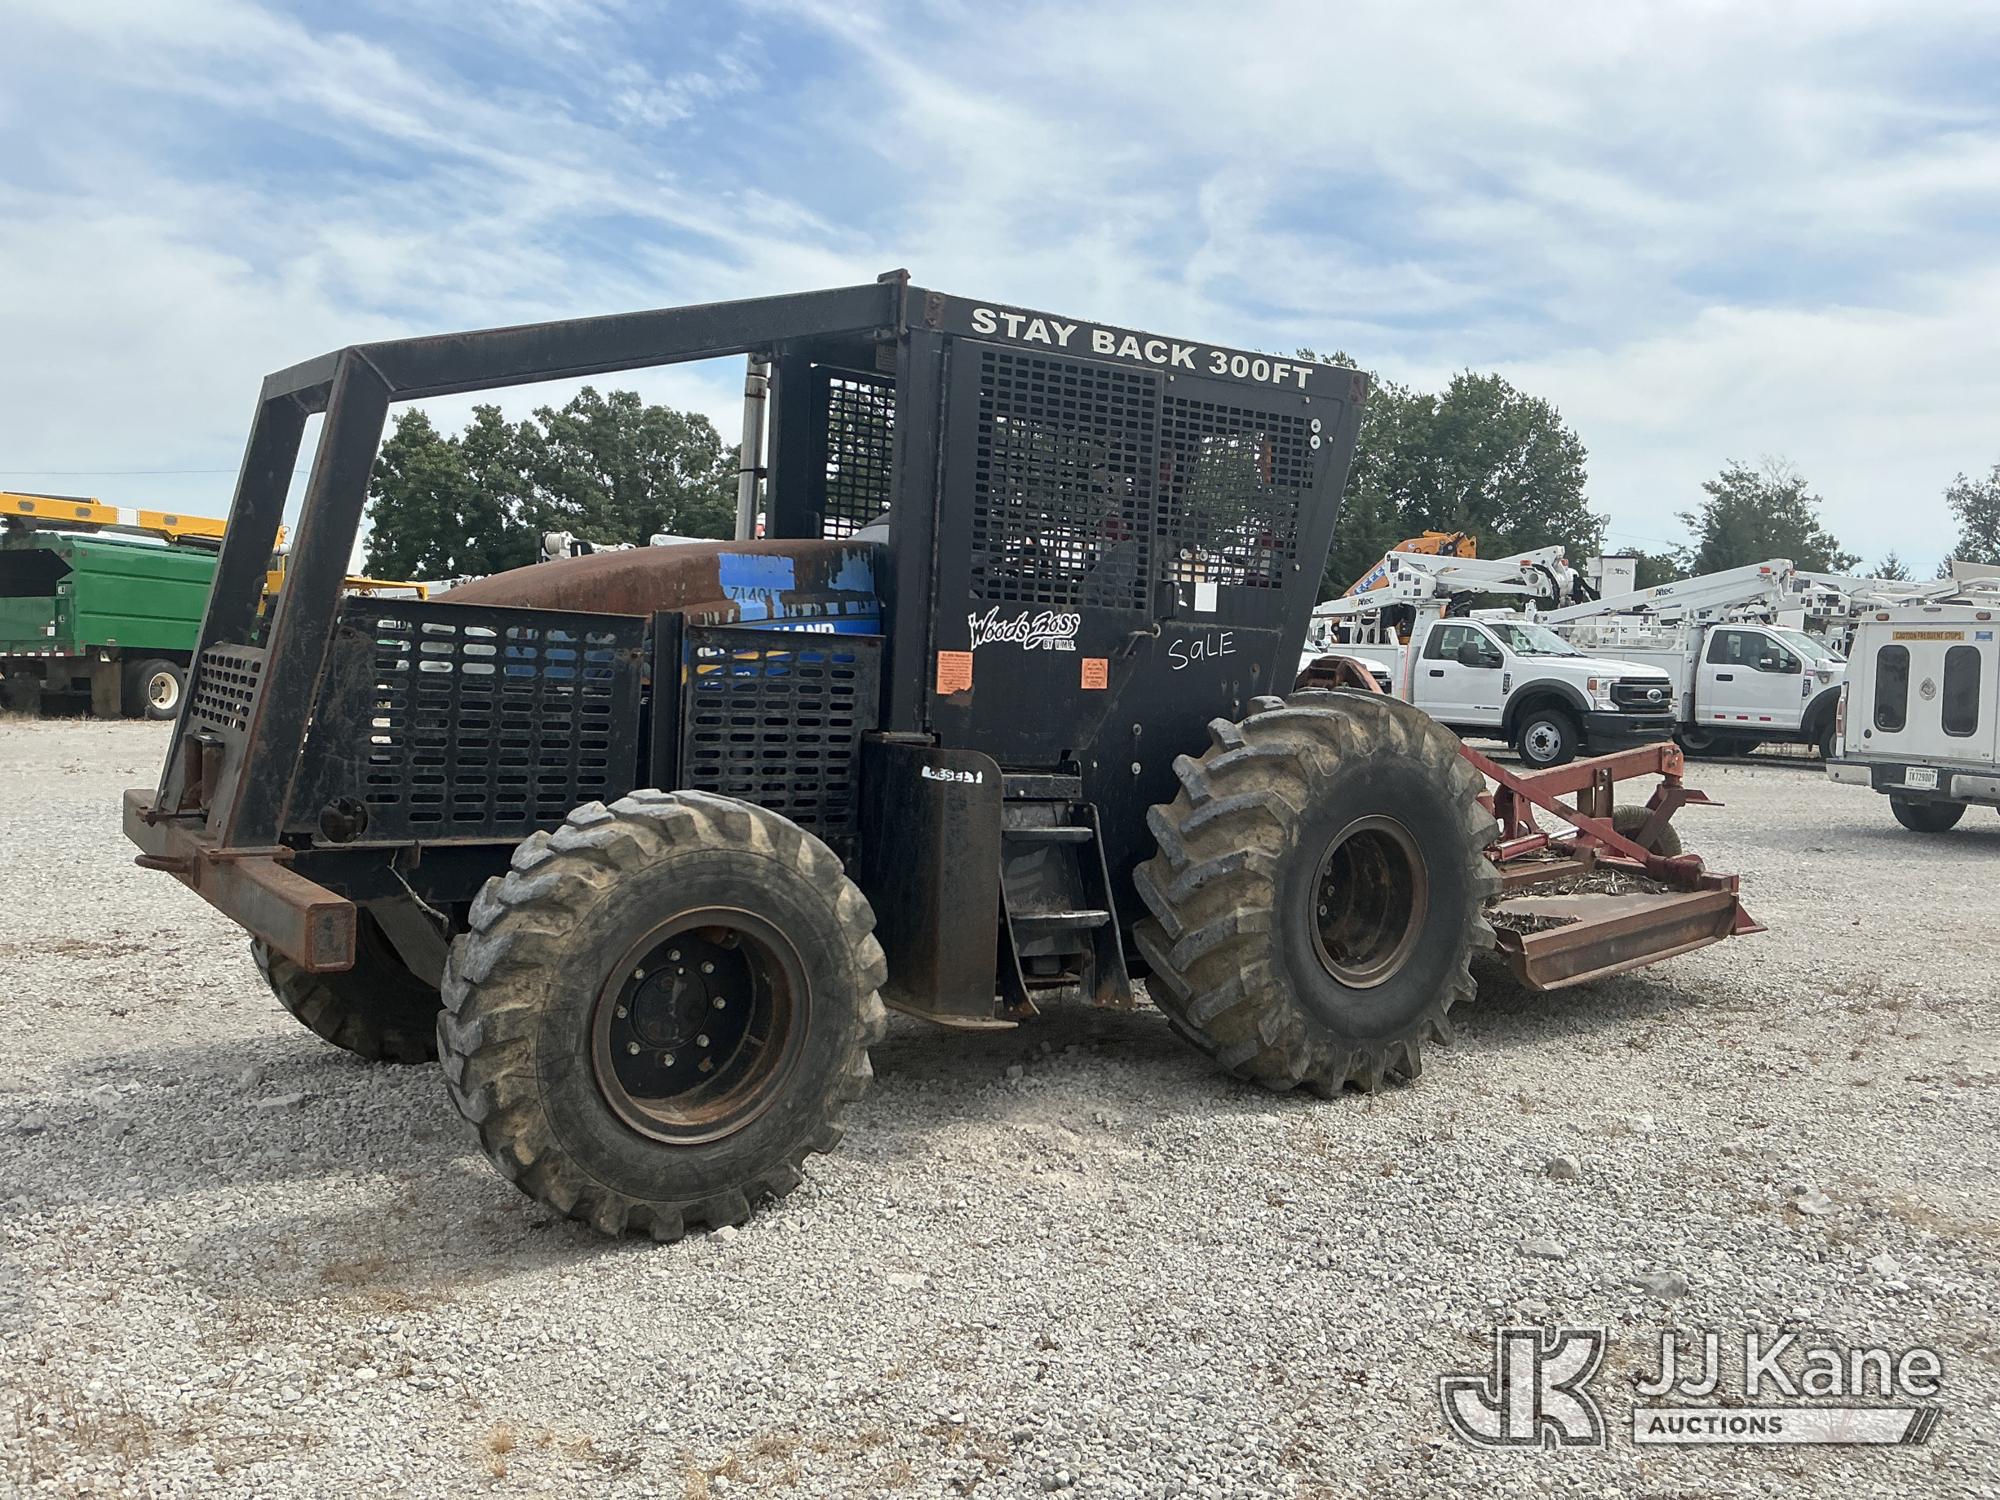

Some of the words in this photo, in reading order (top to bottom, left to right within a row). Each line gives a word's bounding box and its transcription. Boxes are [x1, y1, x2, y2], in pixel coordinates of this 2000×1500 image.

[971, 308, 1078, 347] STAY
[1092, 329, 1197, 370] BACK
[1208, 350, 1313, 390] 300FT
[1655, 587, 1674, 597] Altec
[968, 605, 1030, 651] Woods
